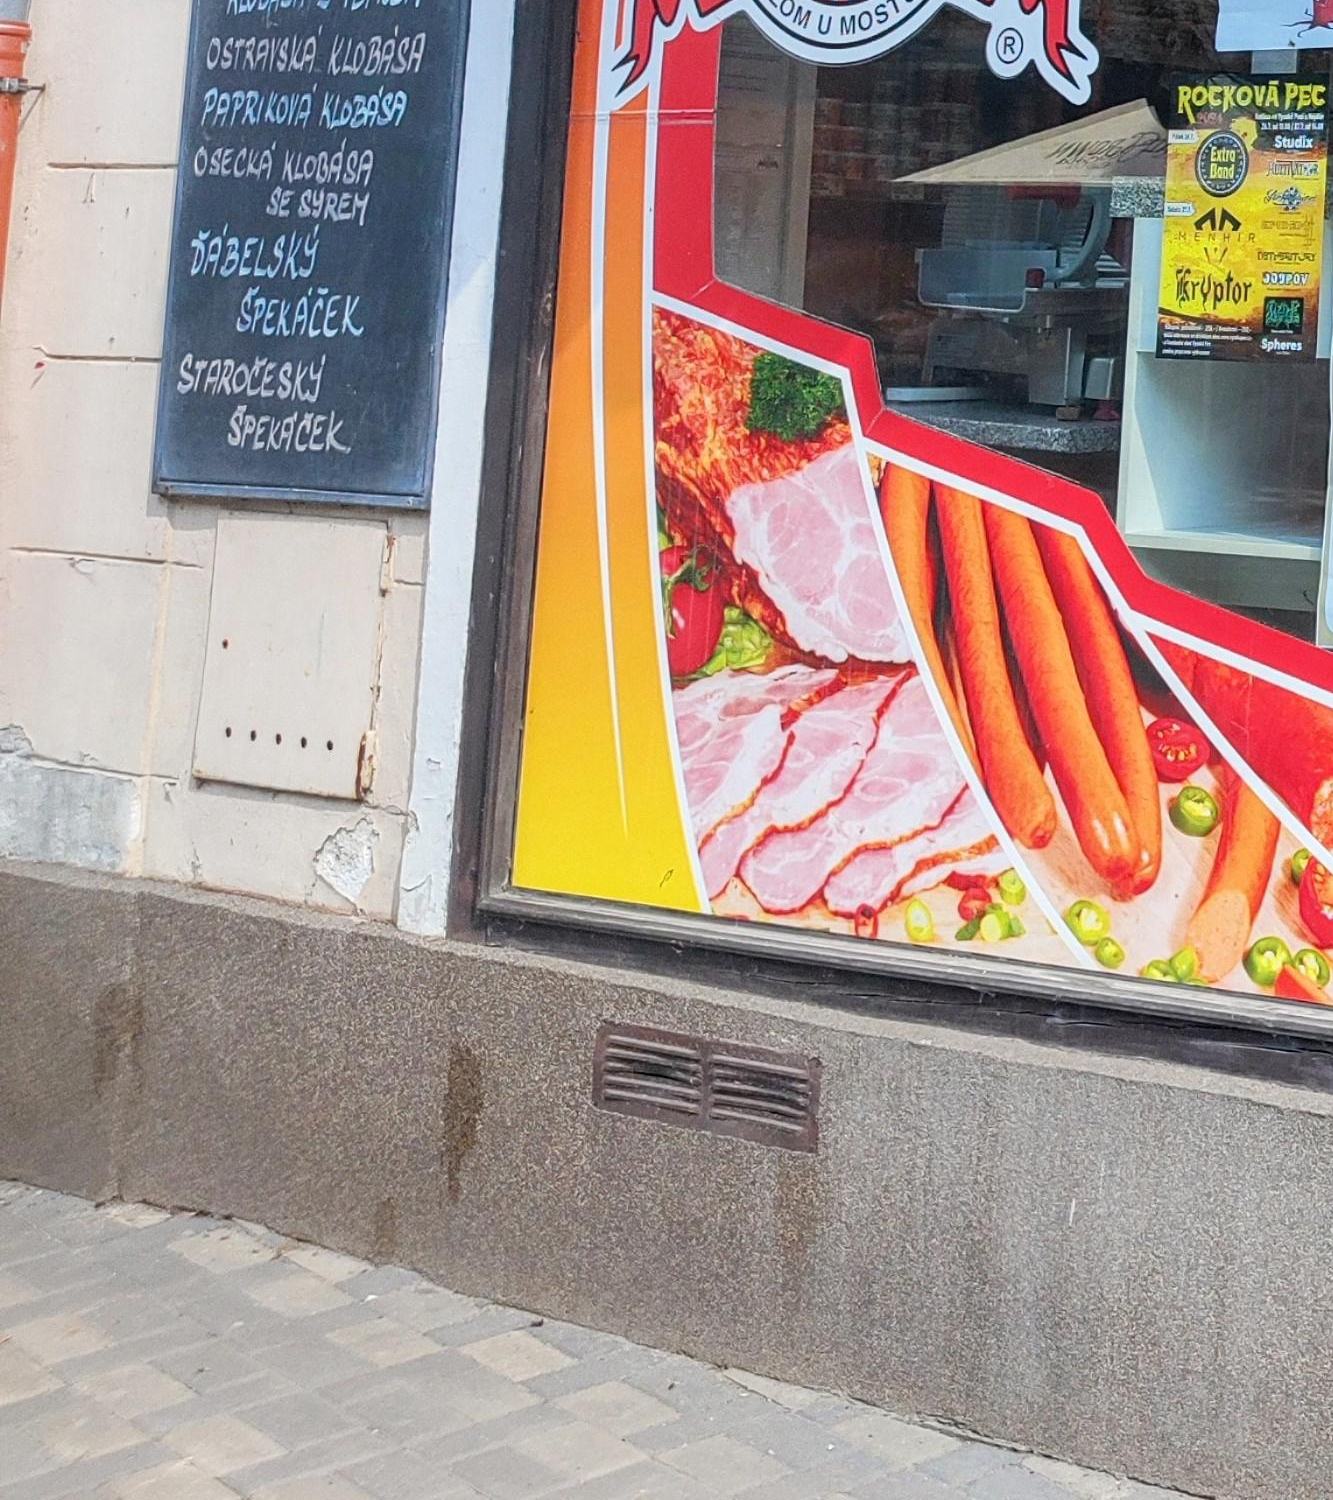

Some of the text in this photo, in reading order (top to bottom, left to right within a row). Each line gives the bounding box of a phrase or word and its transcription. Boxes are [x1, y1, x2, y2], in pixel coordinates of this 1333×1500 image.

[818, 17, 832, 35] U
[206, 24, 426, 76] OSTRAVSKÁ KLOBÁSA
[201, 83, 407, 130] PAPRIKOVÁ KLOBÁSA
[1178, 80, 1326, 124] ROCKOVÁ PEC
[1210, 147, 1235, 162] Extra
[1274, 135, 1313, 149] Studix
[194, 137, 373, 187] OSECKÁ KLOBÁSA
[1210, 164, 1235, 179] Band
[266, 186, 295, 217] SE
[1178, 231, 1256, 243] MENHIR
[236, 285, 364, 338] ŠPEKÁČEK
[1260, 338, 1303, 351] Spheres
[177, 352, 326, 402] STAROČESKÝ
[227, 404, 351, 454] ŠPEKÁČEK
